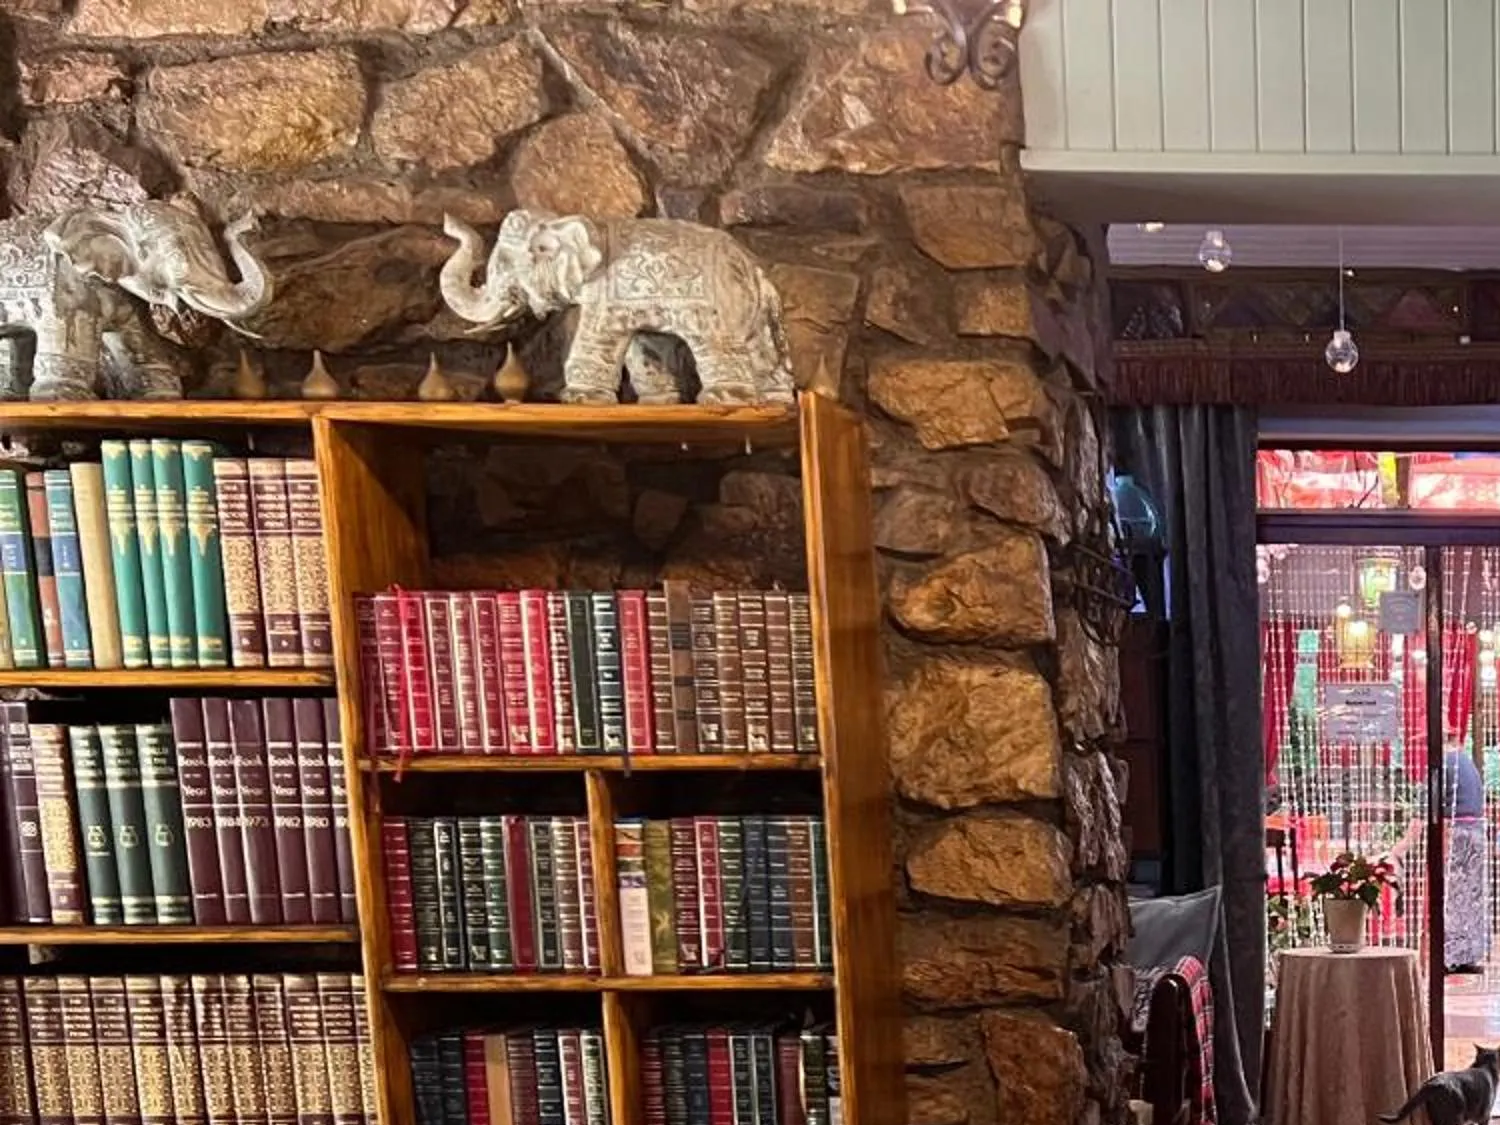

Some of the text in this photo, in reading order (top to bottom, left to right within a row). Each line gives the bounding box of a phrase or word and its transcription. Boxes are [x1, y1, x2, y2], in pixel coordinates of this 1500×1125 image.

[178, 754, 206, 767] Book
[269, 754, 296, 767] Book
[299, 754, 325, 767] Book
[183, 784, 207, 797] Year
[272, 784, 298, 796] Year
[302, 784, 326, 796] Year
